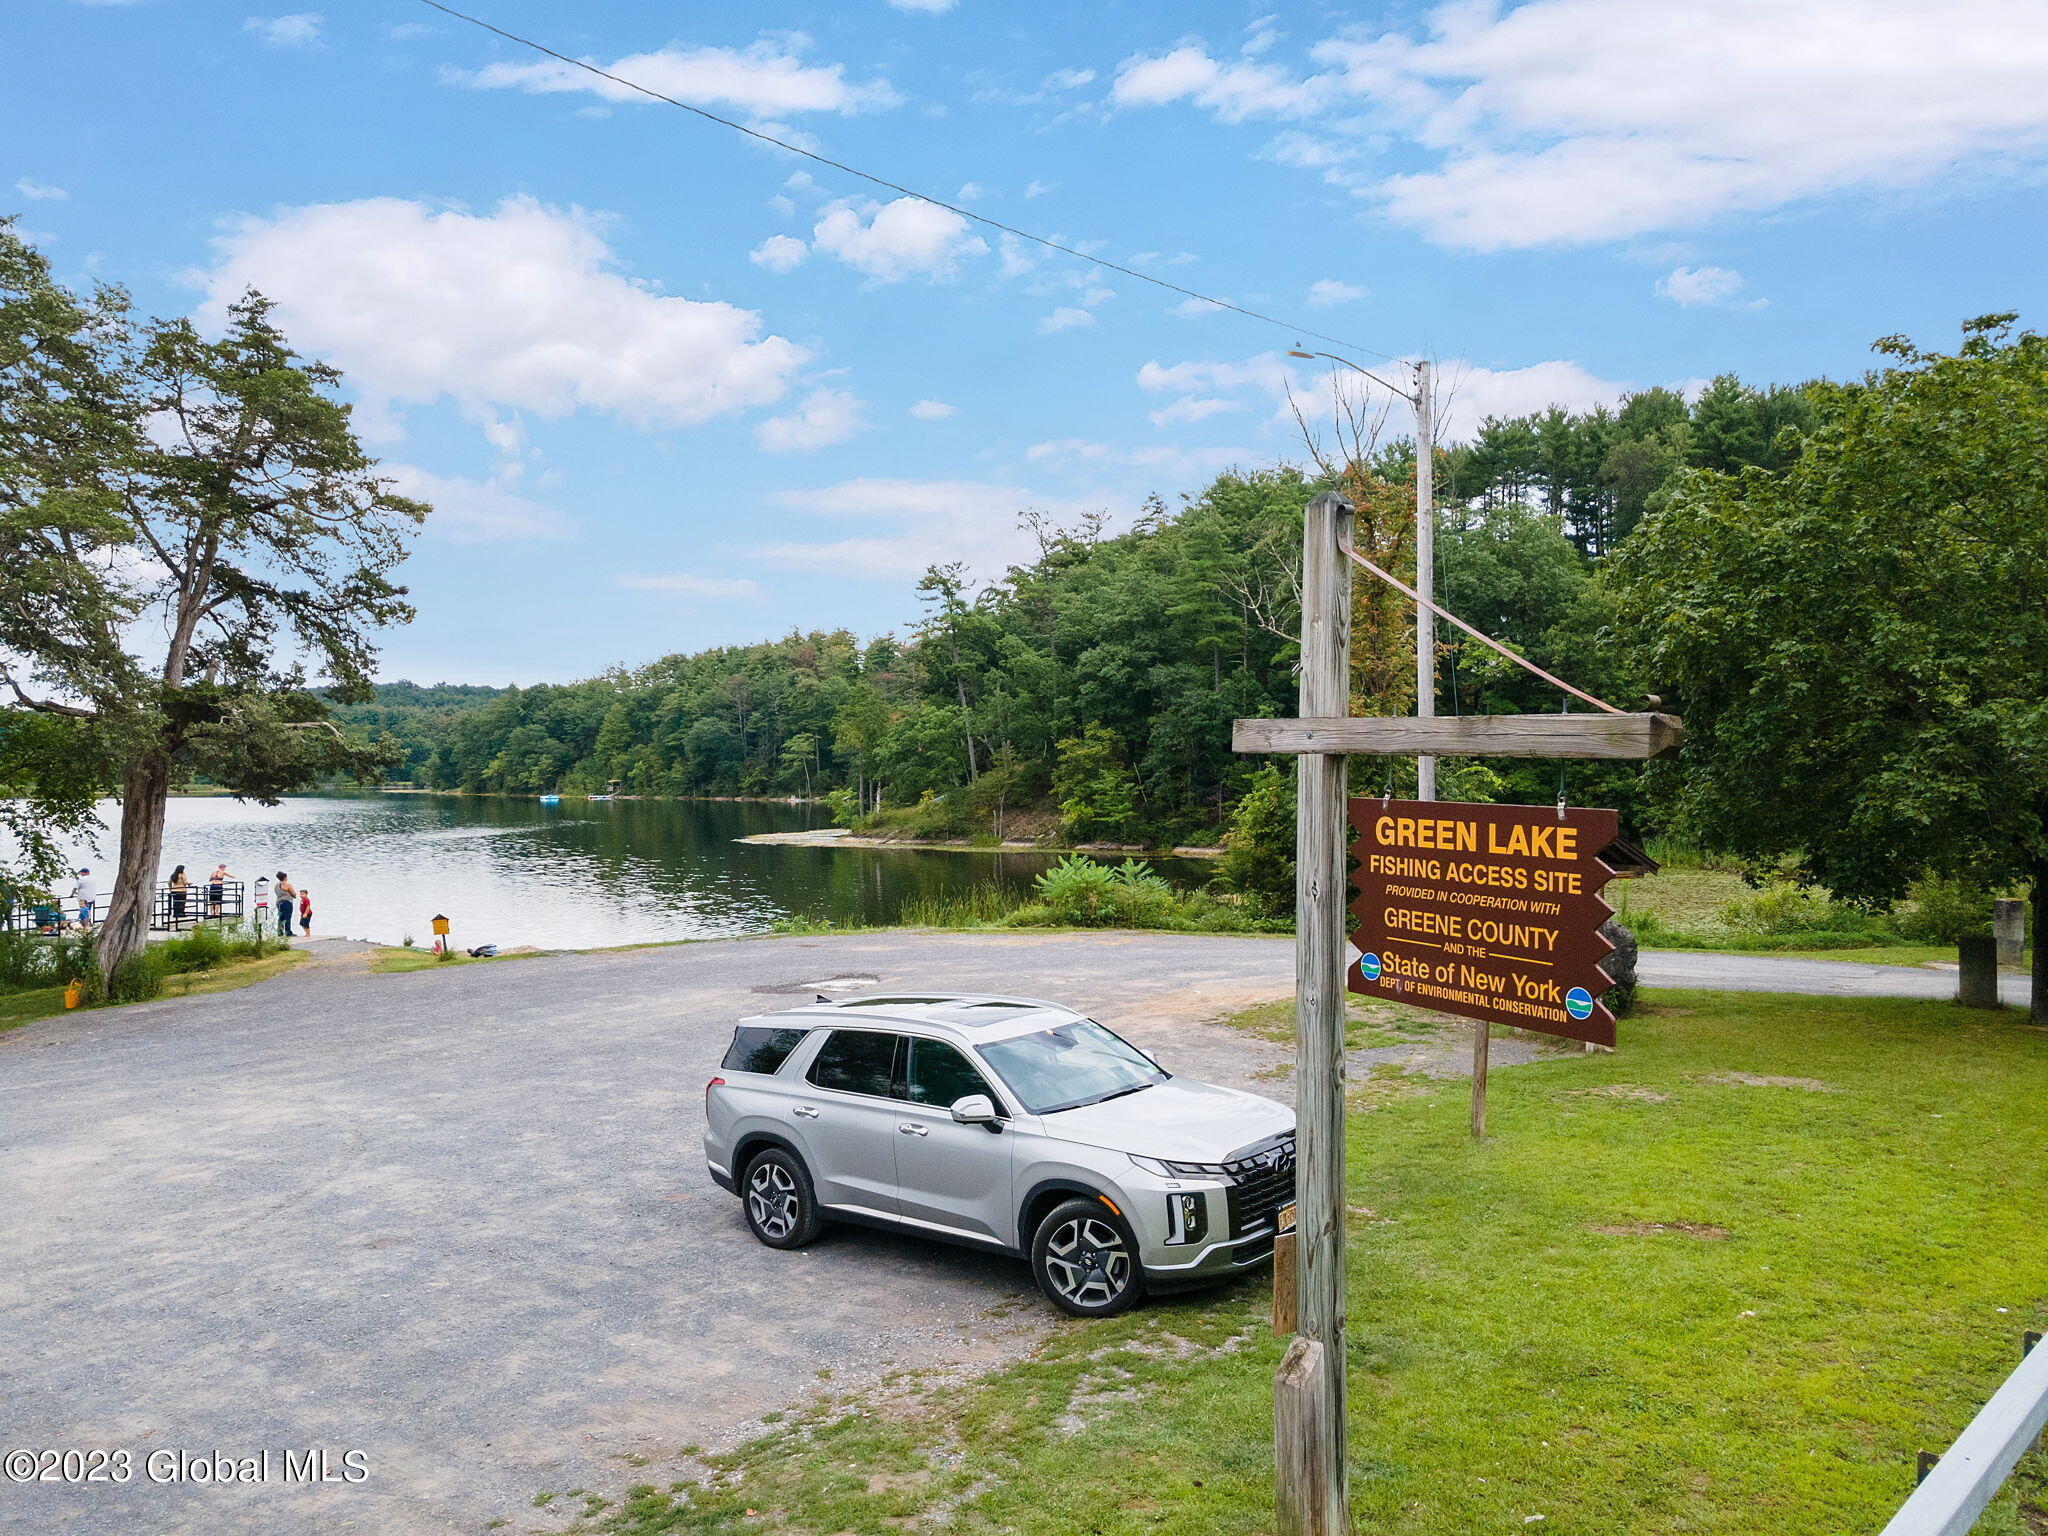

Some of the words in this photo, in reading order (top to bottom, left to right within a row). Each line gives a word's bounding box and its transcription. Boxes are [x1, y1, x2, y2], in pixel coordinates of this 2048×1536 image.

[1376, 816, 1477, 852] GREEN
[1489, 824, 1578, 860] LAKE
[1370, 854, 1440, 880] FISHING
[1446, 861, 1527, 889] ACCESS
[1534, 870, 1582, 895] SITE
[1385, 885, 1434, 900] PROVIDED
[1437, 891, 1447, 902] IN
[1450, 892, 1527, 912] COOPERATION
[1530, 902, 1560, 915] WITH
[1384, 908, 1462, 937] GREENE
[1467, 919, 1559, 951] COUNTY
[1444, 942, 1464, 955] AND
[1466, 945, 1486, 958] THE
[1382, 951, 1430, 979] State
[1436, 963, 1454, 983] of
[1461, 965, 1505, 993] New
[1512, 973, 1561, 1004] York
[1380, 976, 1402, 991] DEPT.
[1404, 981, 1415, 992] OF
[1417, 983, 1491, 1008] ENVIRONMENTAL
[1493, 997, 1567, 1023] CONSERVATION
